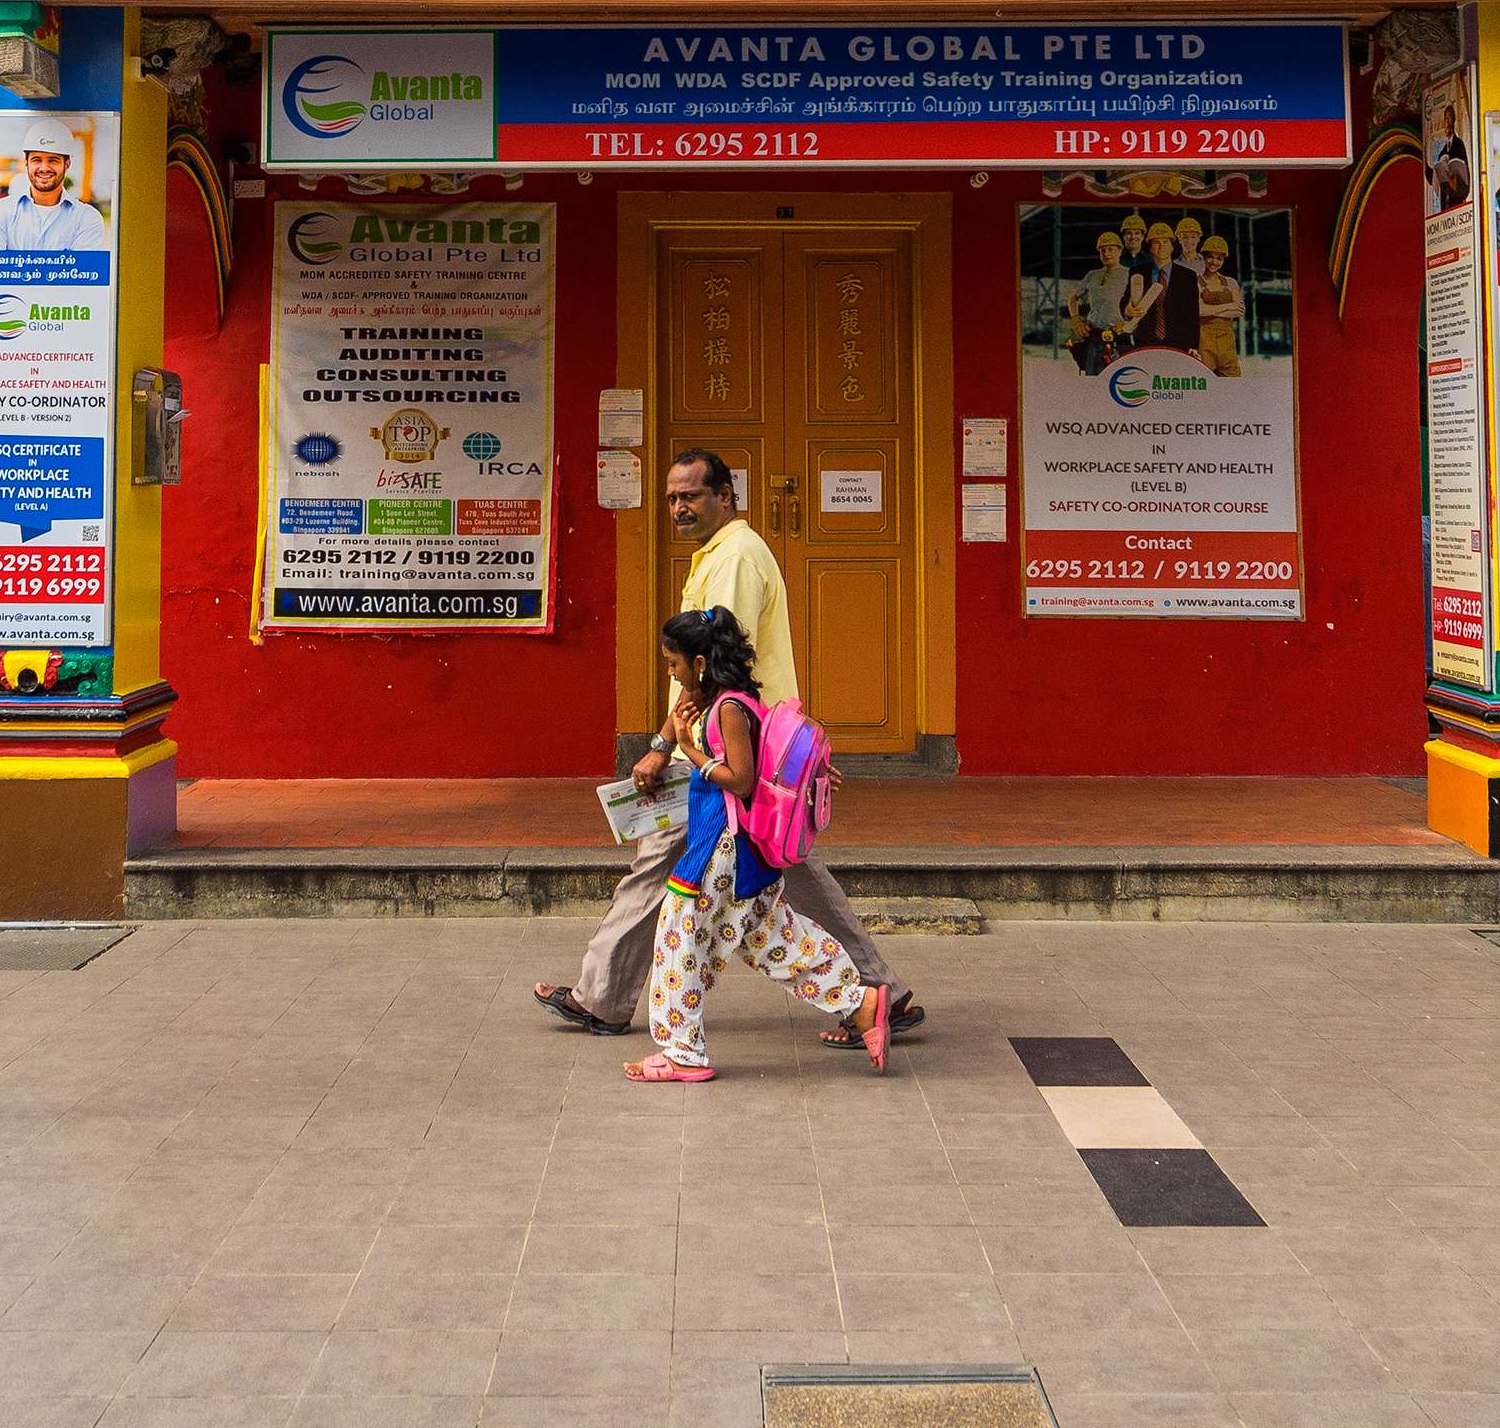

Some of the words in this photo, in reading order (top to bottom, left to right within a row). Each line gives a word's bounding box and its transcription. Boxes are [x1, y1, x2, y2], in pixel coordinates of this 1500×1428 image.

[643, 36, 825, 62] AVANTA
[848, 35, 1021, 61] GLOBAL
[1044, 35, 1111, 60] PTE
[1135, 34, 1206, 60] LTD
[370, 71, 482, 101] Avanta
[605, 73, 661, 88] MOM
[675, 73, 727, 88] WDA
[741, 72, 801, 88] SCDF
[809, 71, 915, 92] Approved
[922, 71, 995, 91] Safety
[1001, 71, 1093, 90] Training
[1100, 70, 1243, 90] Organization
[370, 104, 434, 121] Global
[635, 100, 677, 115] வள
[585, 131, 665, 157] TEL:
[674, 131, 743, 157] 6295
[753, 131, 820, 156] 2112
[1054, 130, 1111, 154] HP:
[1121, 129, 1188, 154] 9119
[1197, 129, 1266, 154] 2200
[350, 215, 541, 245] Avanta
[350, 247, 433, 263] Global
[446, 247, 488, 262] Pte
[500, 247, 542, 263] Ltd
[300, 270, 325, 280] MOM
[329, 270, 391, 280] ACCREDITED
[394, 270, 432, 280] SAFETY
[435, 270, 484, 280] TRAINING
[487, 271, 527, 281] CENTRE
[29, 303, 91, 321] Avanta
[29, 322, 65, 332] Global
[340, 327, 484, 340] TRAINING
[339, 348, 484, 361] AUDITING
[316, 368, 507, 382] CONSULTING
[19, 379, 51, 389] SAFETY
[52, 379, 71, 389] AND
[72, 379, 107, 389] HEALTH
[1152, 375, 1207, 391] Avanta
[8, 396, 107, 409] CO-ORDINATOR
[302, 389, 521, 404] OUTSOURCING
[1151, 391, 1184, 401] Global
[1045, 422, 1083, 438] WSQ
[1085, 422, 1173, 436] ADVANCED
[1175, 423, 1272, 437] CERTIFICATE
[12, 444, 82, 457] CERTIFICATE
[1152, 444, 1166, 456] IN
[295, 470, 340, 478] nebosh
[478, 462, 543, 476] IRCA
[1044, 461, 1132, 474] WORKPLACE
[1133, 462, 1184, 474] SAFETY
[1187, 462, 1218, 475] AND
[1220, 463, 1274, 475] HEALTH
[17, 487, 45, 499] AND
[45, 487, 92, 499] HEALTH
[835, 486, 868, 494] RAHMAN
[1131, 481, 1172, 494] (LEVEL
[1174, 482, 1188, 494] B)
[285, 499, 330, 508] BENDEMEER
[332, 500, 361, 508] CENTRE
[378, 500, 411, 509] PIONEER
[413, 500, 443, 509] CENTRE
[474, 500, 496, 509] TUAS
[497, 500, 529, 509] CENTRE
[831, 495, 851, 504] 8654
[853, 495, 873, 504] 0045
[1049, 500, 1099, 512] SAFETY
[1102, 500, 1211, 514] CO-ORDINATOR
[1213, 502, 1269, 514] COURSE
[1124, 535, 1193, 550] Contact
[47, 555, 100, 572] 2112
[283, 550, 342, 565] 6295
[348, 550, 397, 565] 2112
[418, 550, 472, 565] 9119
[476, 550, 535, 565] 2200
[282, 568, 333, 579] Email:
[339, 568, 535, 581] training@avanta.com.sg
[1026, 560, 1082, 579] 6295
[1088, 560, 1145, 579] 2112
[1174, 561, 1231, 580] 9119
[1235, 561, 1293, 580] 2200
[46, 578, 101, 596] 6999
[299, 592, 519, 617] www.avanta.com.sg
[1040, 596, 1155, 609] training@avanta.com.sg
[1176, 598, 1296, 609] www.avanta.com.sg
[1443, 596, 1461, 613] 6295
[1462, 599, 1482, 616] 2112
[1443, 618, 1462, 637] 9119
[1463, 622, 1482, 640] 6999
